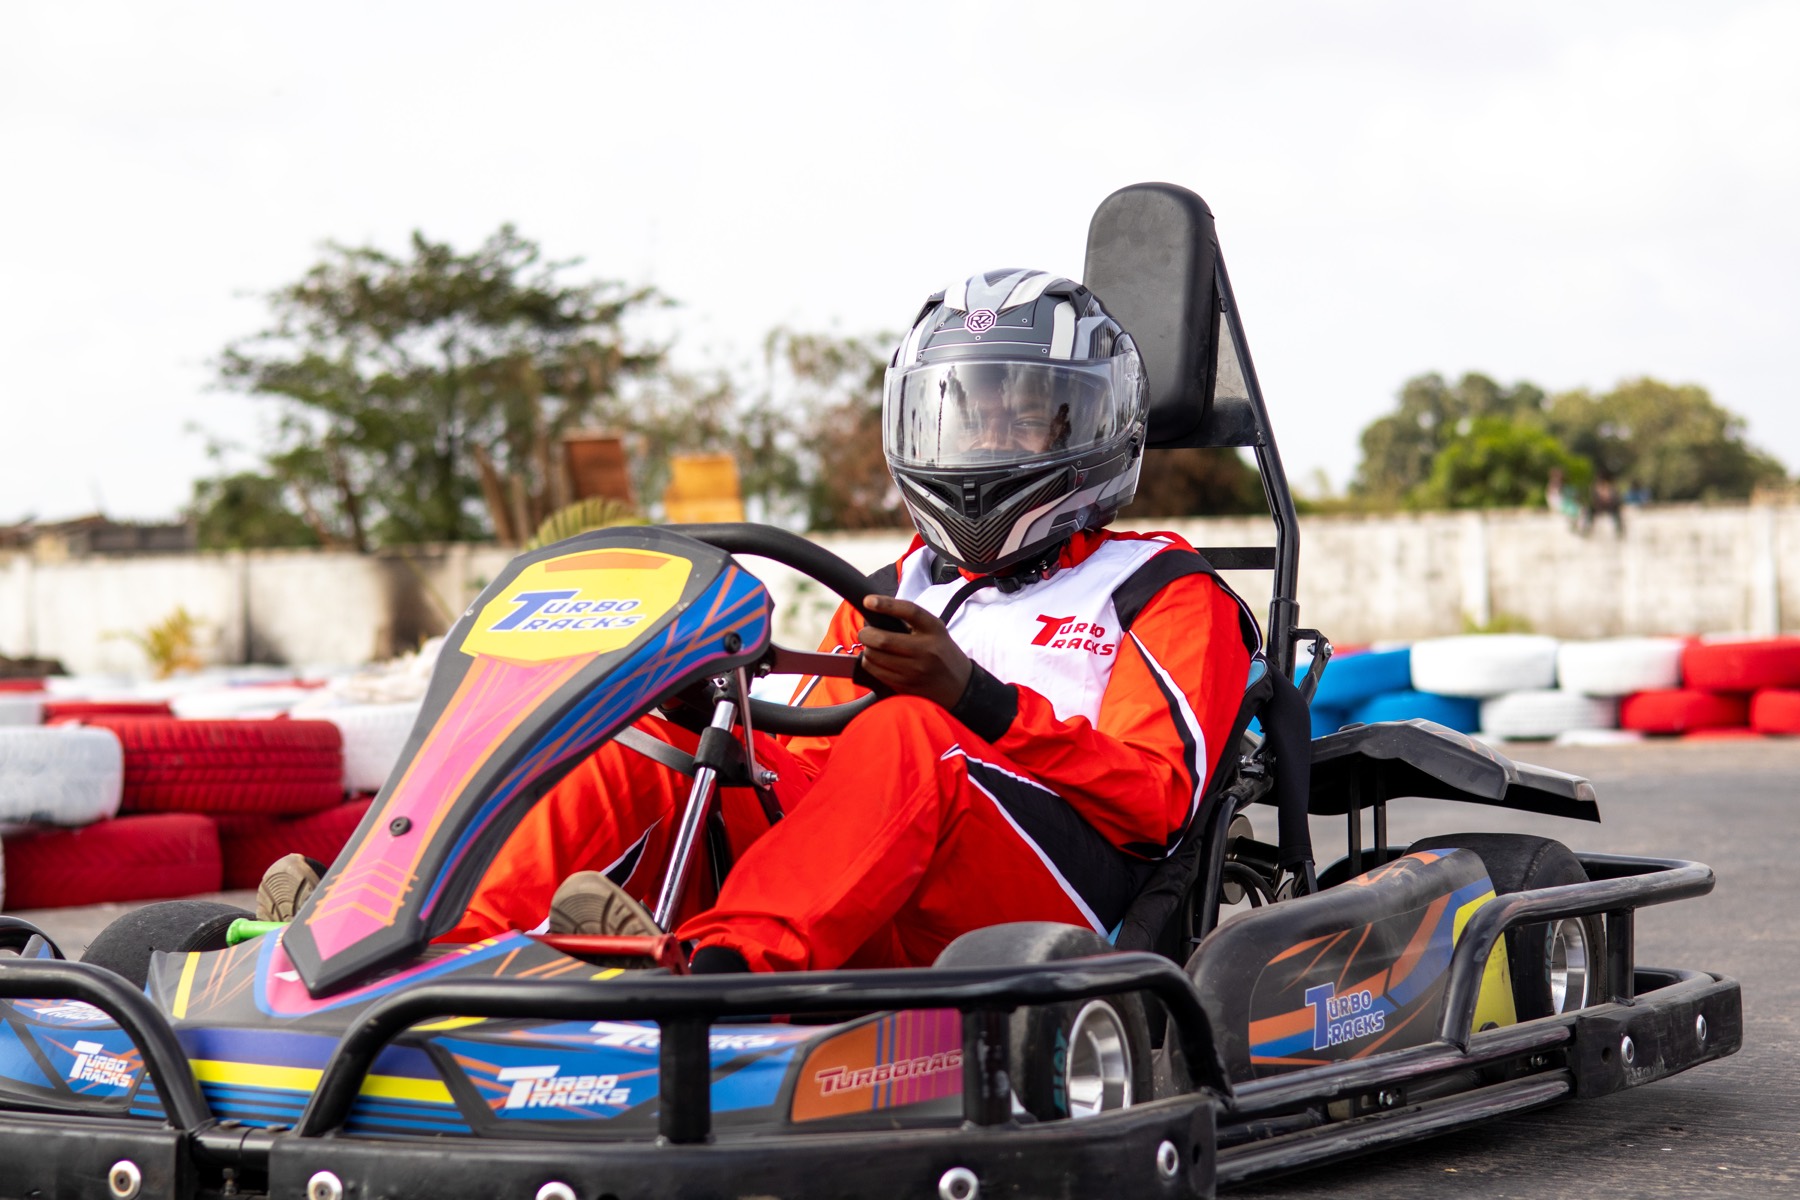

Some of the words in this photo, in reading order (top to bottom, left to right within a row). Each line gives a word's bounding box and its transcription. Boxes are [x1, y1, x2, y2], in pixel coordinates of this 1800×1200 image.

[489, 589, 640, 631] TURBO
[1305, 982, 1372, 1051] TURBO
[69, 1040, 128, 1080] TURBO
[815, 1049, 963, 1097] TURBORAC
[497, 1065, 619, 1108] TURBO
